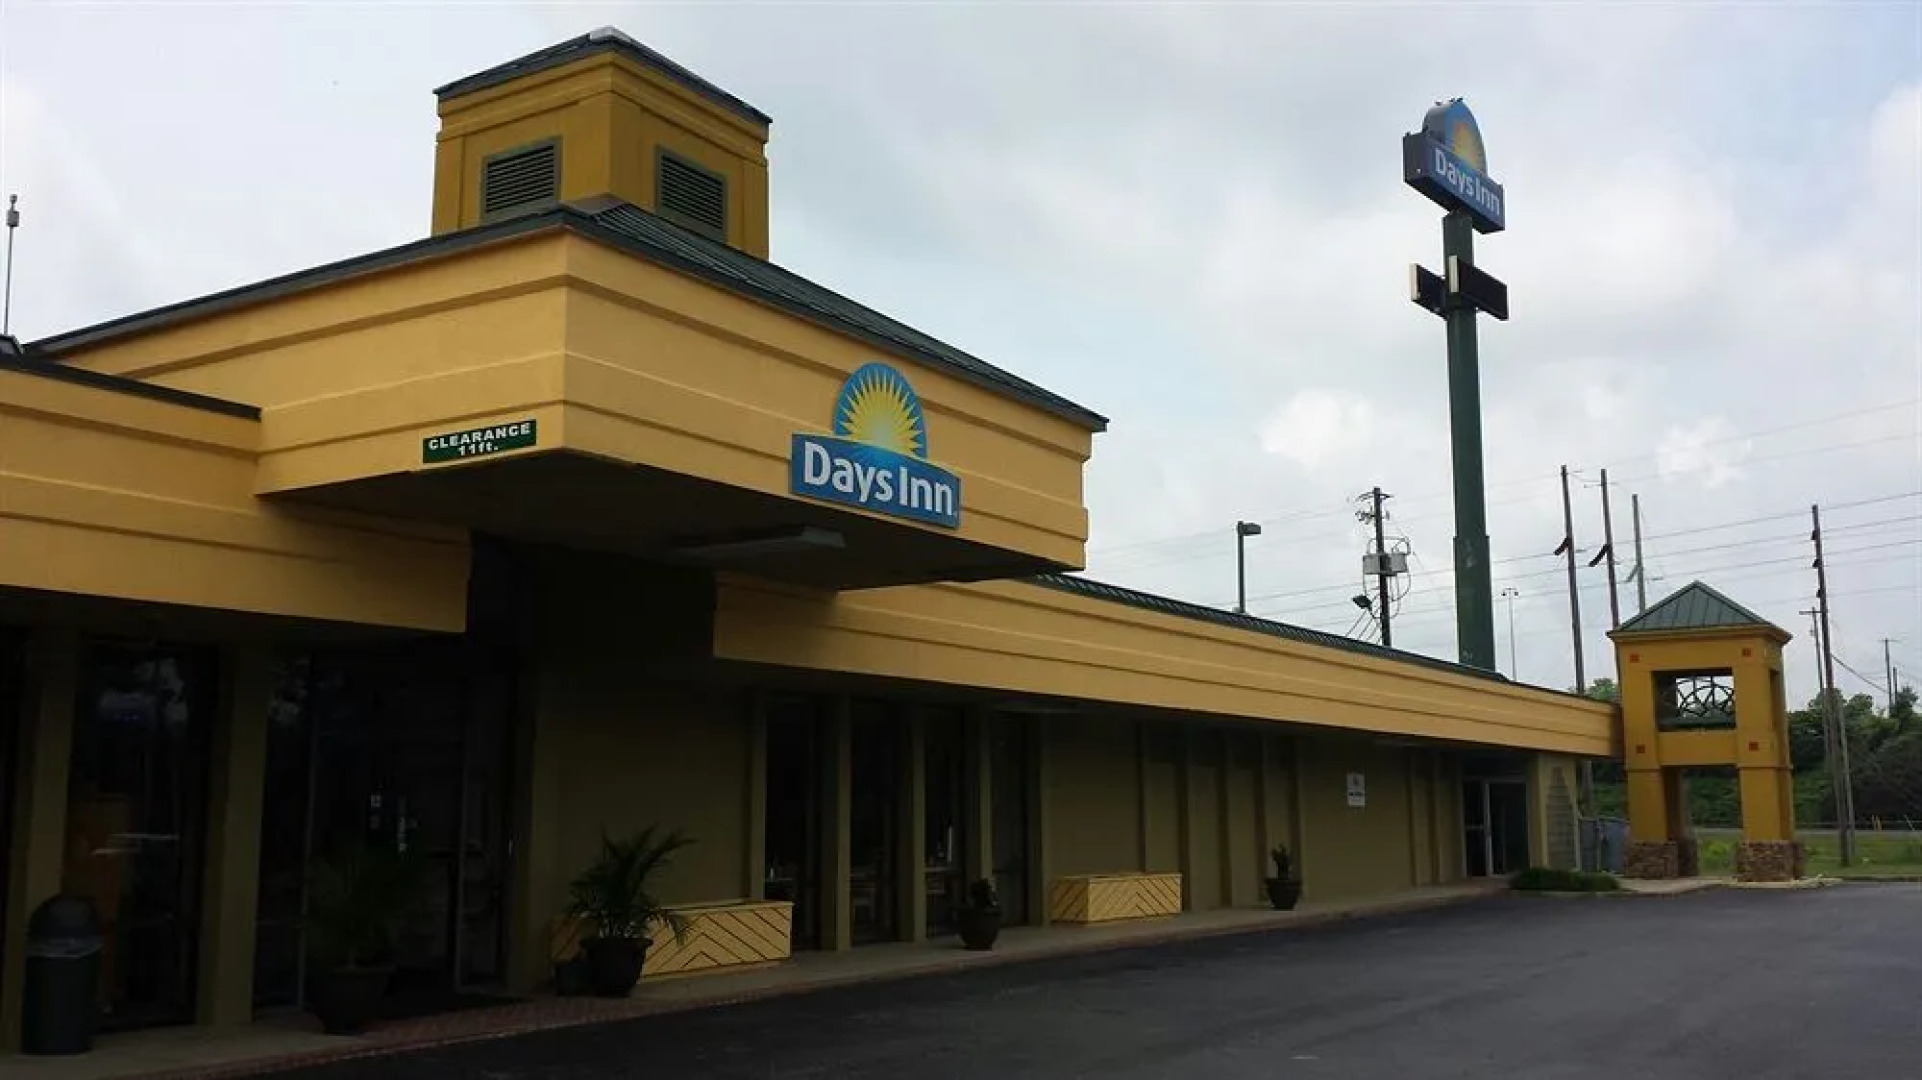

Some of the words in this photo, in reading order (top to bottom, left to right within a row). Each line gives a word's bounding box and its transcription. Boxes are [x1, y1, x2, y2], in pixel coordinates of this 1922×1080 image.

[1435, 147, 1474, 197] Days
[1475, 177, 1500, 216] Inn
[428, 422, 531, 450] CLEARANCE
[804, 441, 893, 502] Days
[899, 466, 953, 516] Inn
